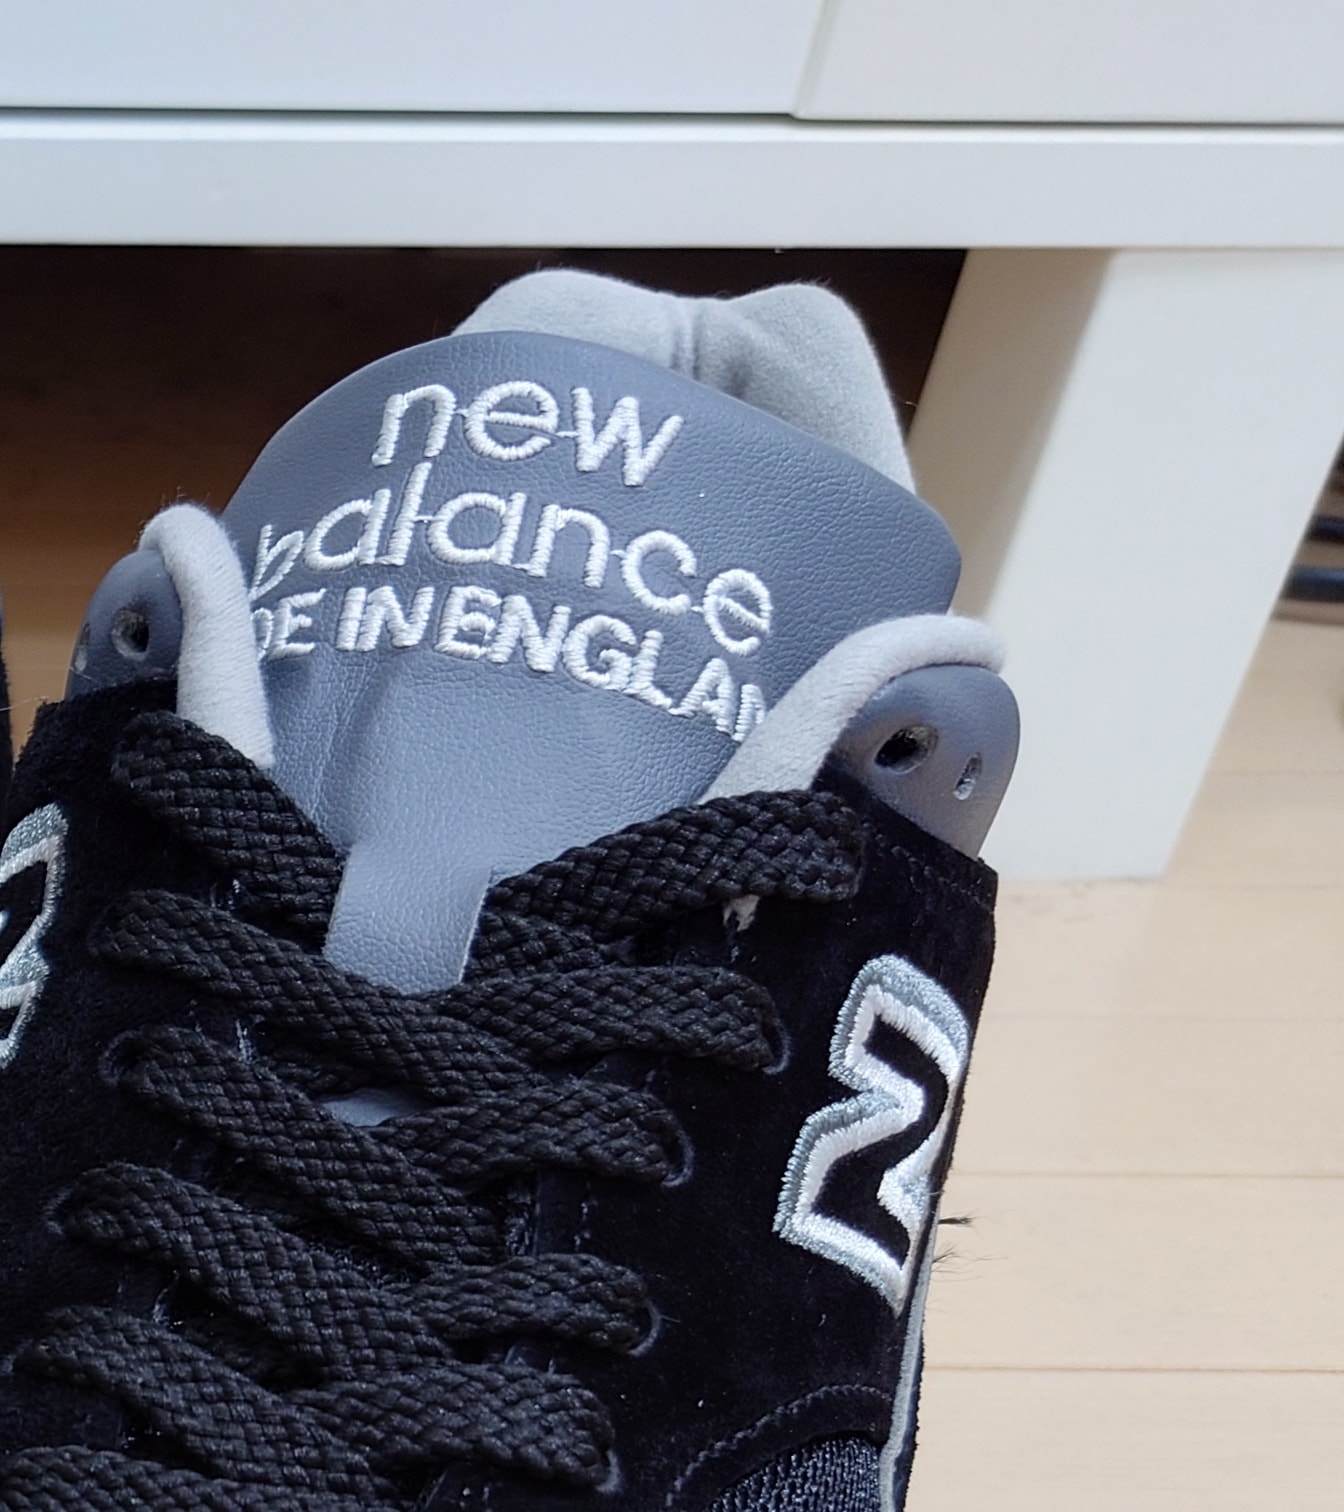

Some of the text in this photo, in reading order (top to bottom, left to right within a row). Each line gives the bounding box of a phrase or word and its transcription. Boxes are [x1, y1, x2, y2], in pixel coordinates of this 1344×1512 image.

[371, 380, 684, 486] new
[248, 462, 774, 656] balance
[249, 584, 766, 742] DE IN ENGLAN
